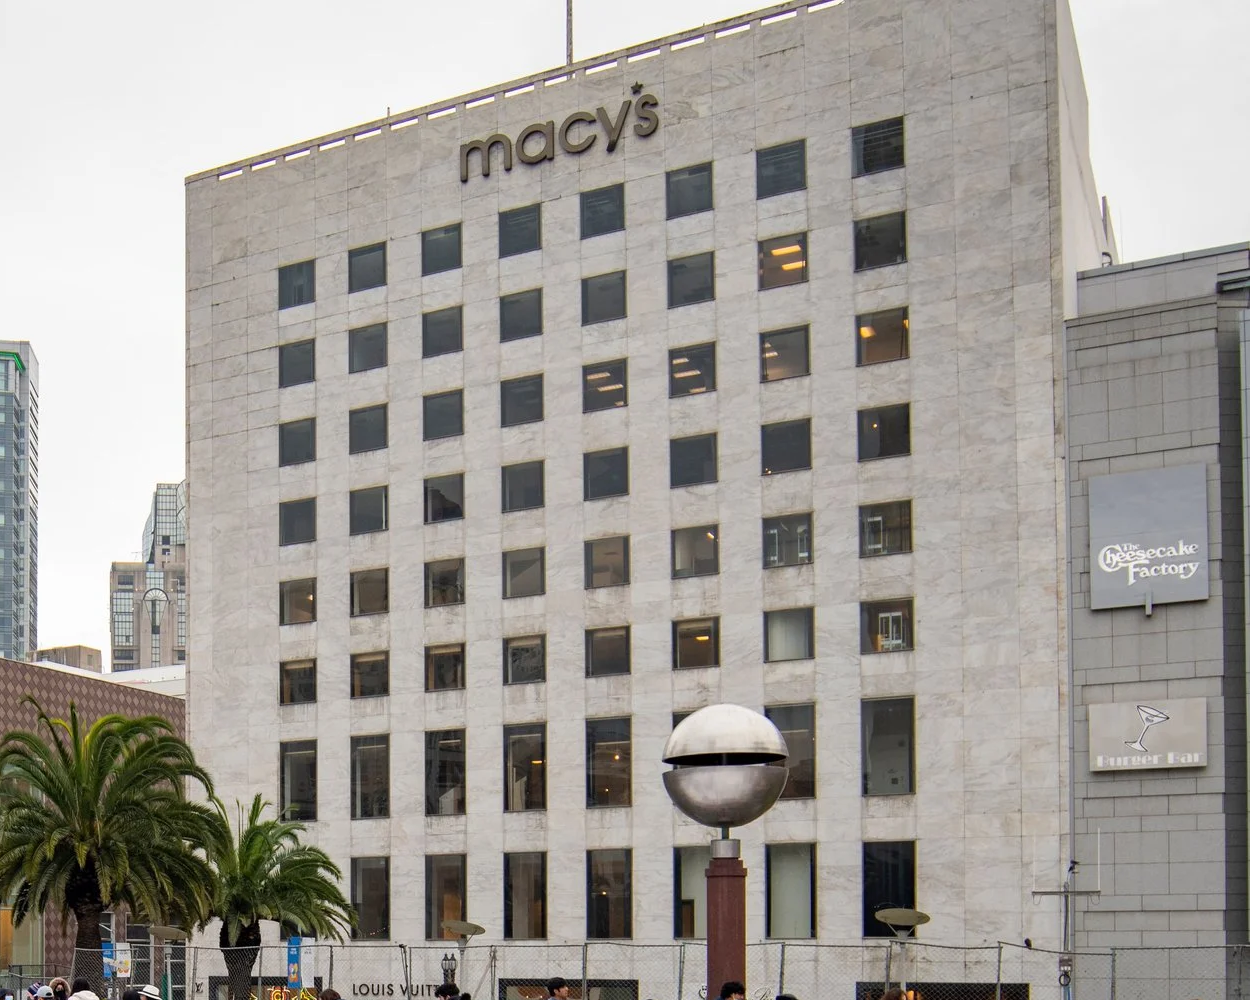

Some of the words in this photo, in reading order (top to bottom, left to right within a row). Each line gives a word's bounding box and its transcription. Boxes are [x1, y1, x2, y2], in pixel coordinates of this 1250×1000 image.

[1098, 540, 1199, 573] Cheesecake
[1121, 543, 1141, 552] The
[1117, 560, 1200, 585] Factory
[352, 983, 394, 996] LOUIS
